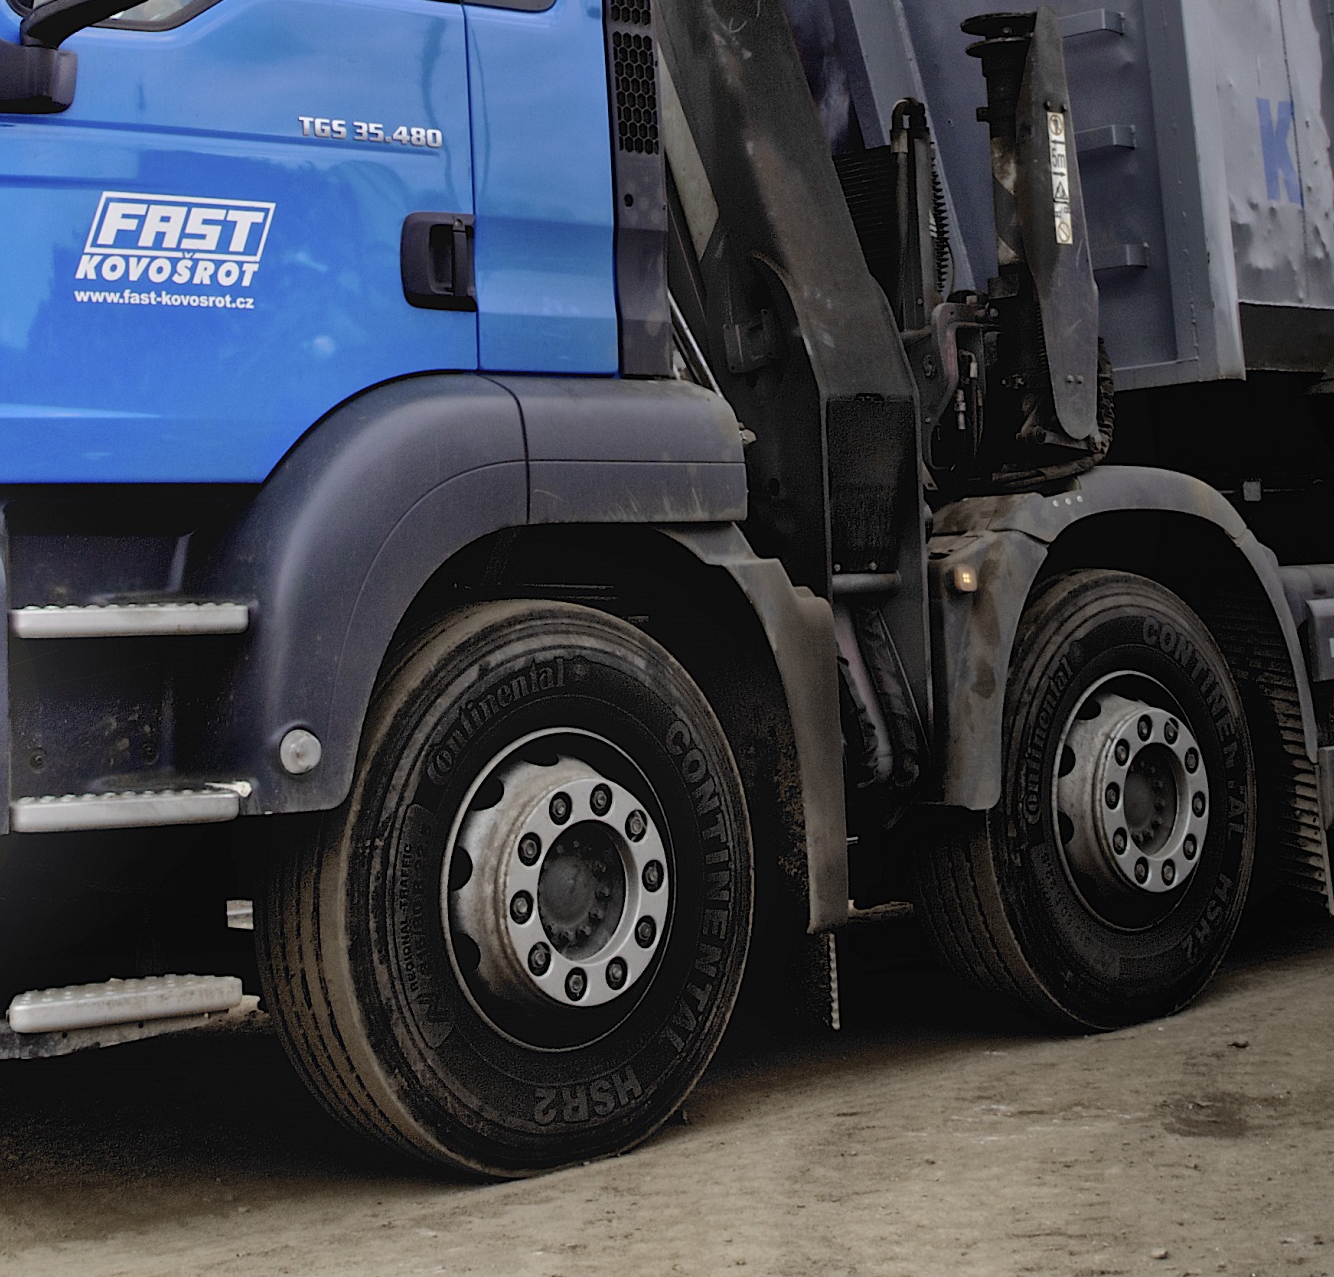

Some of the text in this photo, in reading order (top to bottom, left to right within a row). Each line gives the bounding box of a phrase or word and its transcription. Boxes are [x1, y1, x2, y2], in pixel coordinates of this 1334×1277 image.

[298, 116, 443, 148] TGS 35.480
[96, 201, 266, 253] FAST
[74, 252, 260, 287] KOVOŠROT
[74, 290, 255, 309] www.fast-kovosrot.cz
